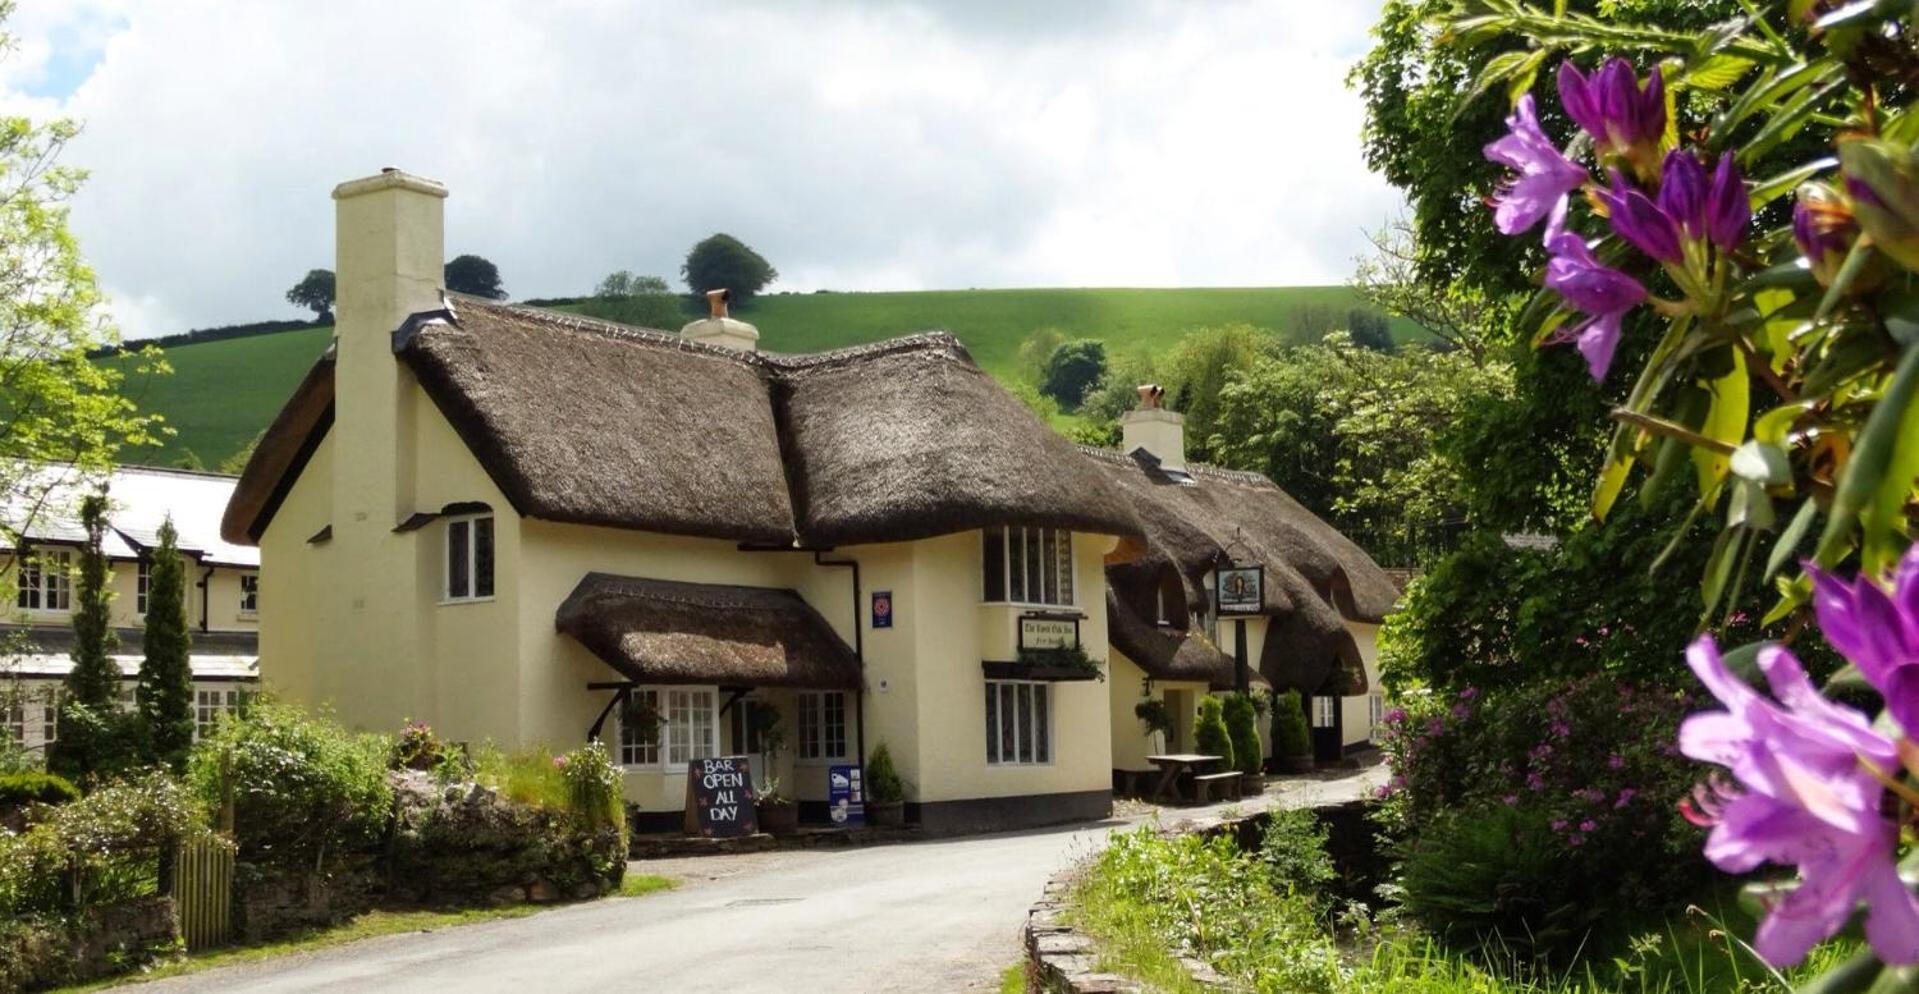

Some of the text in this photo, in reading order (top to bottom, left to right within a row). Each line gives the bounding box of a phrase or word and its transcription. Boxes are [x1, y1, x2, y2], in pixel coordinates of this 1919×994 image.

[703, 759, 735, 774] BAR
[703, 772, 743, 789] OPEN
[715, 790, 738, 805] ALL
[709, 806, 738, 822] DAY
